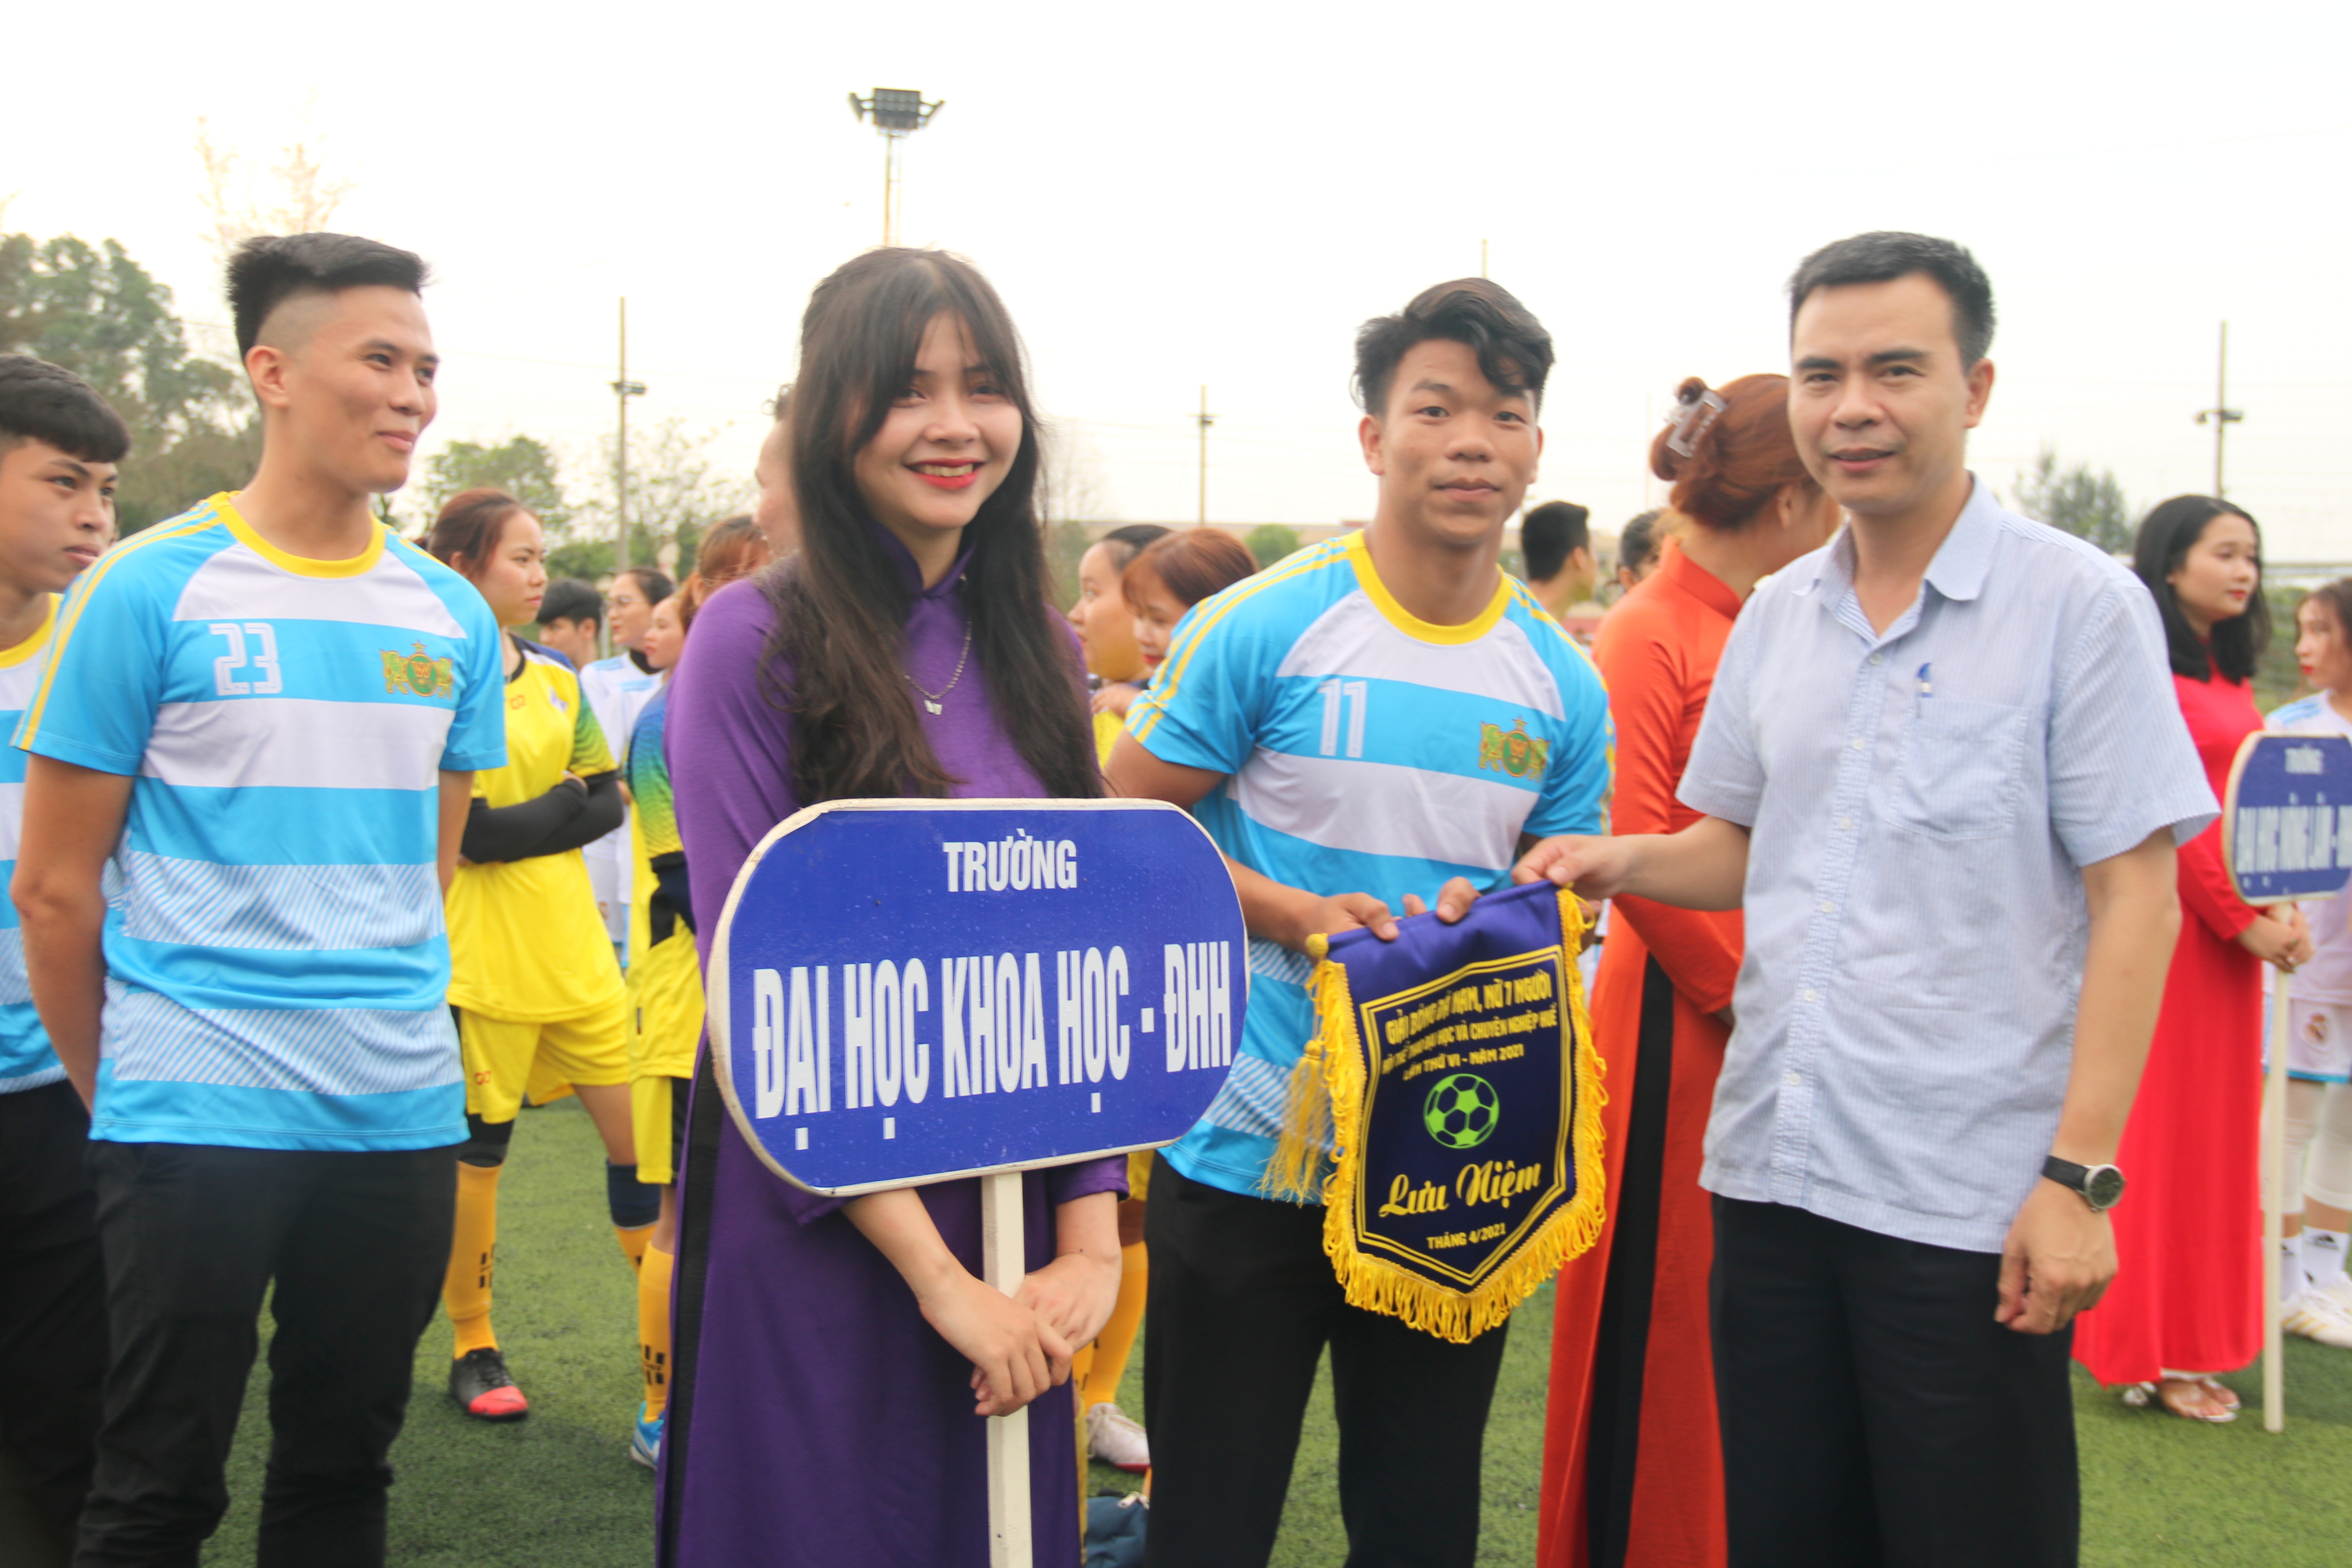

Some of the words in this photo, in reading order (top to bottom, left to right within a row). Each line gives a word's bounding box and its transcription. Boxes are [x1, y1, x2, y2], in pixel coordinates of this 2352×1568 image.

[208, 622, 283, 696] 23
[1317, 679, 1367, 759] 11
[942, 828, 1078, 893] TRƯỜNG
[752, 965, 831, 1151] ĐẠI
[843, 958, 930, 1140] HỌC
[941, 952, 1049, 1099] KHOA
[1056, 945, 1131, 1113] HỌC
[1163, 940, 1231, 1073] ĐHH
[1446, 1053, 1461, 1067] VI
[1498, 1043, 1524, 1061] 2021
[1378, 1174, 1449, 1218] Lưu
[1456, 1160, 1541, 1209] Niệm
[1426, 1232, 1467, 1250] THÁNG
[1468, 1222, 1506, 1243] 4/2021
